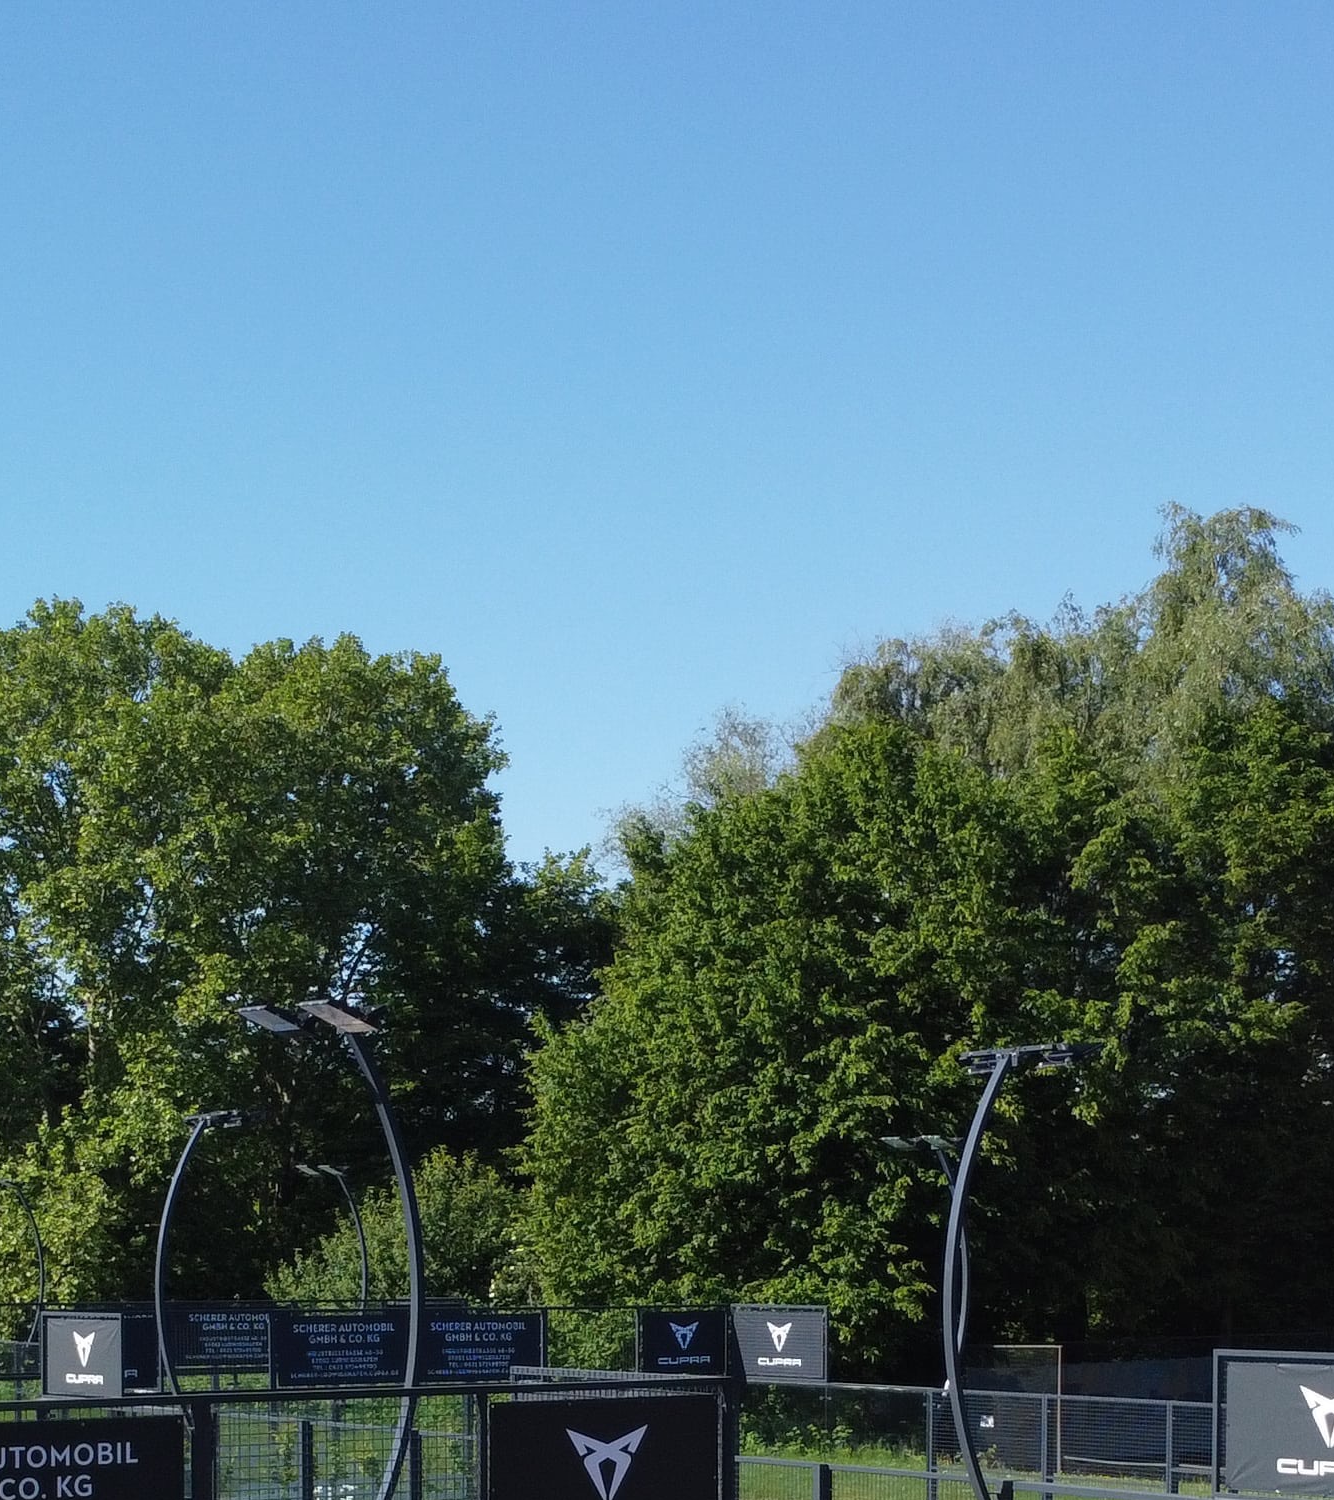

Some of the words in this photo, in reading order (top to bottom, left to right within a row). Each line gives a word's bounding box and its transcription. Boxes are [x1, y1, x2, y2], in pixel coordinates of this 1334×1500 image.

[188, 1313, 228, 1322] SCHERER
[202, 1323, 229, 1331] GMBH
[292, 1323, 336, 1333] SCHERER
[339, 1322, 395, 1333] AUTOMOBIL
[430, 1321, 472, 1331] SCHERER
[474, 1321, 527, 1331] AUTOMOBIL
[308, 1335, 337, 1344] GMBH
[367, 1334, 381, 1343] KG
[444, 1333, 473, 1342] GMBH
[500, 1332, 512, 1341] KG
[657, 1355, 711, 1366] CUPRA
[757, 1356, 802, 1368] CUPRA
[65, 1373, 104, 1385] CUPRA
[56, 1474, 94, 1498] KG
